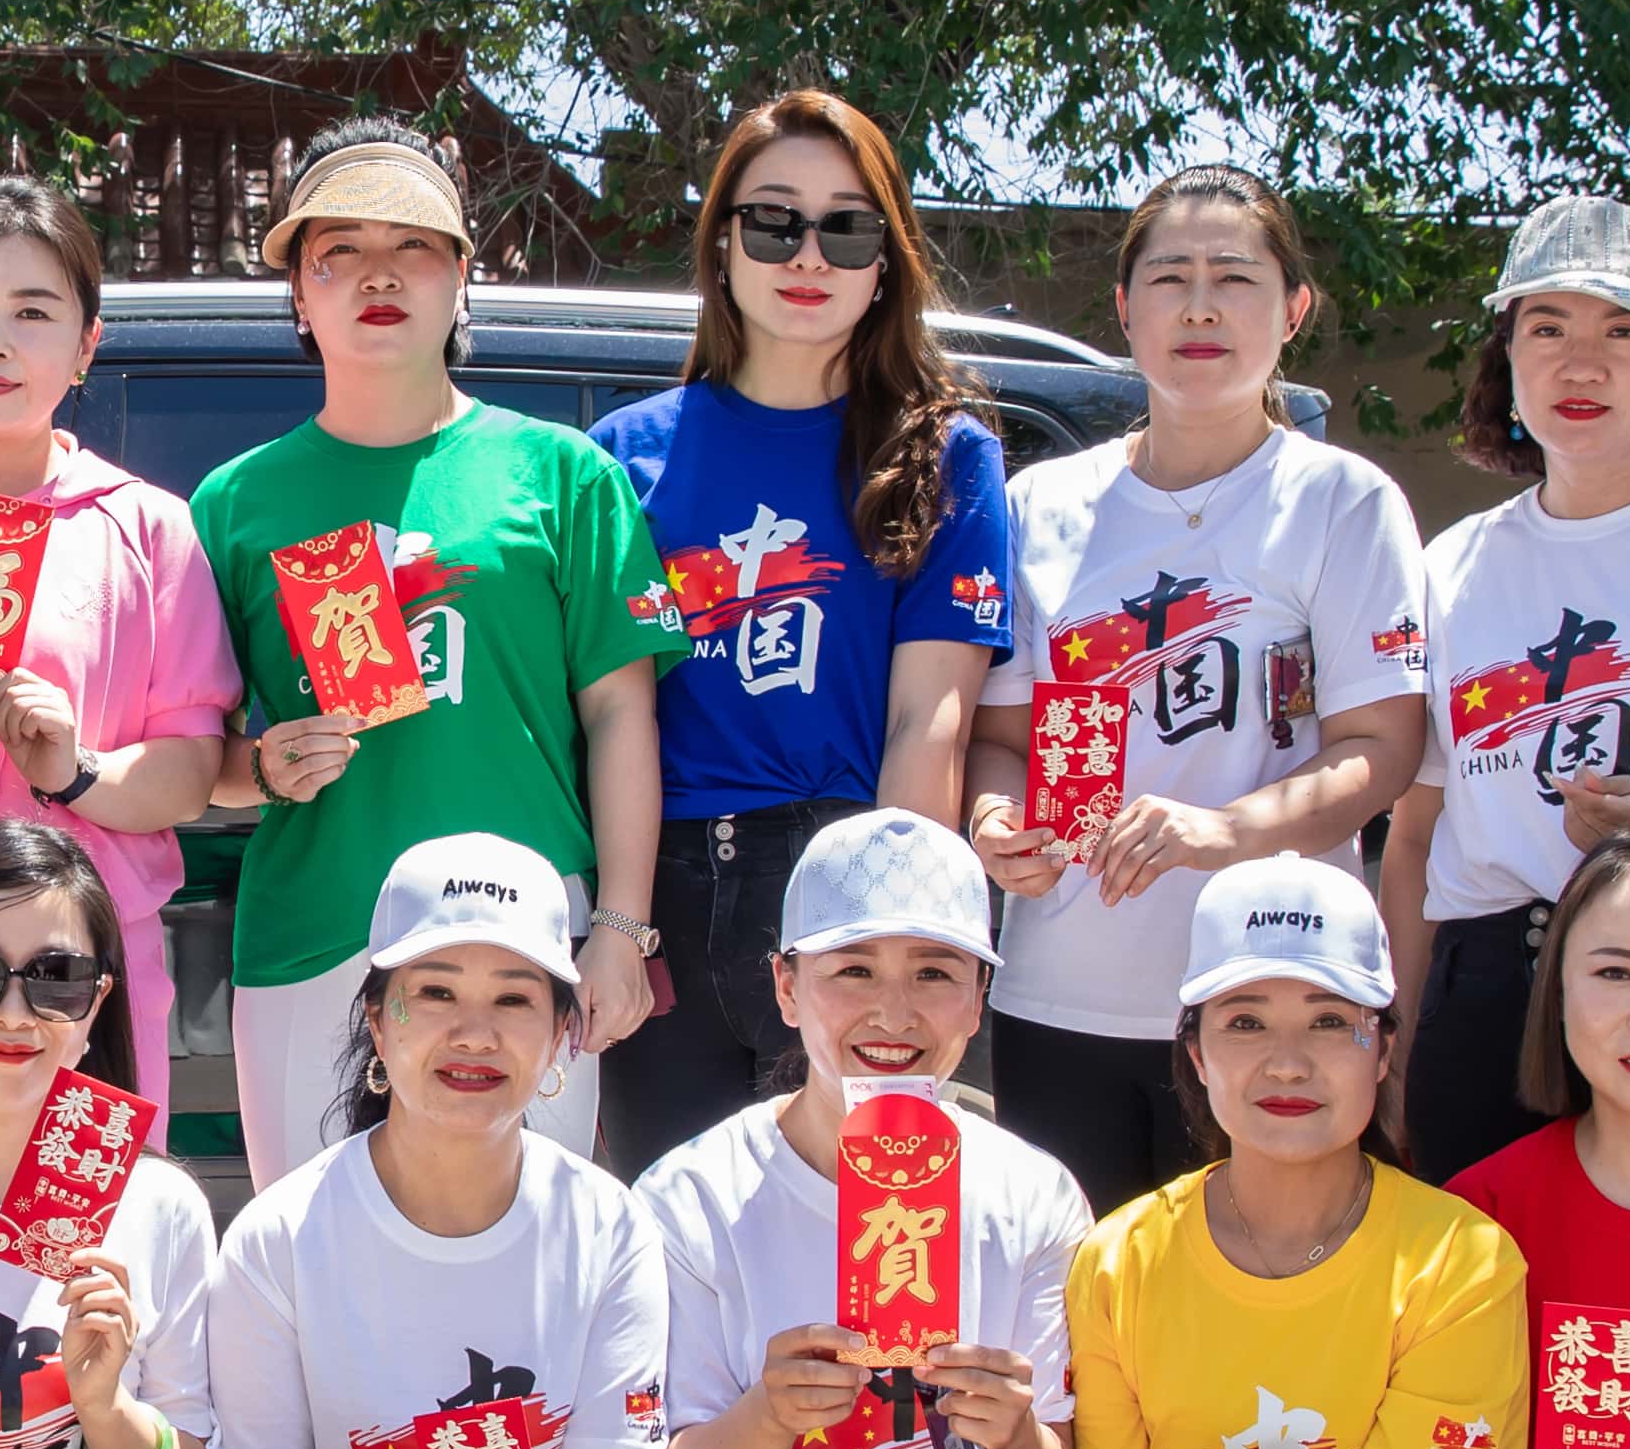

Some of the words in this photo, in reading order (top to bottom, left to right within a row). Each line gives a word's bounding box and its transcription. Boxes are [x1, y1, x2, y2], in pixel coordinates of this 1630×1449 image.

[643, 580, 684, 633] 中国
[719, 502, 825, 696] 中国
[973, 566, 1001, 627] 中国
[309, 583, 394, 679] 賀
[1120, 570, 1242, 746] 中国
[1395, 614, 1429, 673] 中国
[1460, 749, 1524, 780] CHINA
[46, 1086, 137, 1150] 恭喜
[32, 1126, 126, 1193] 發財
[851, 1194, 949, 1307] 賀
